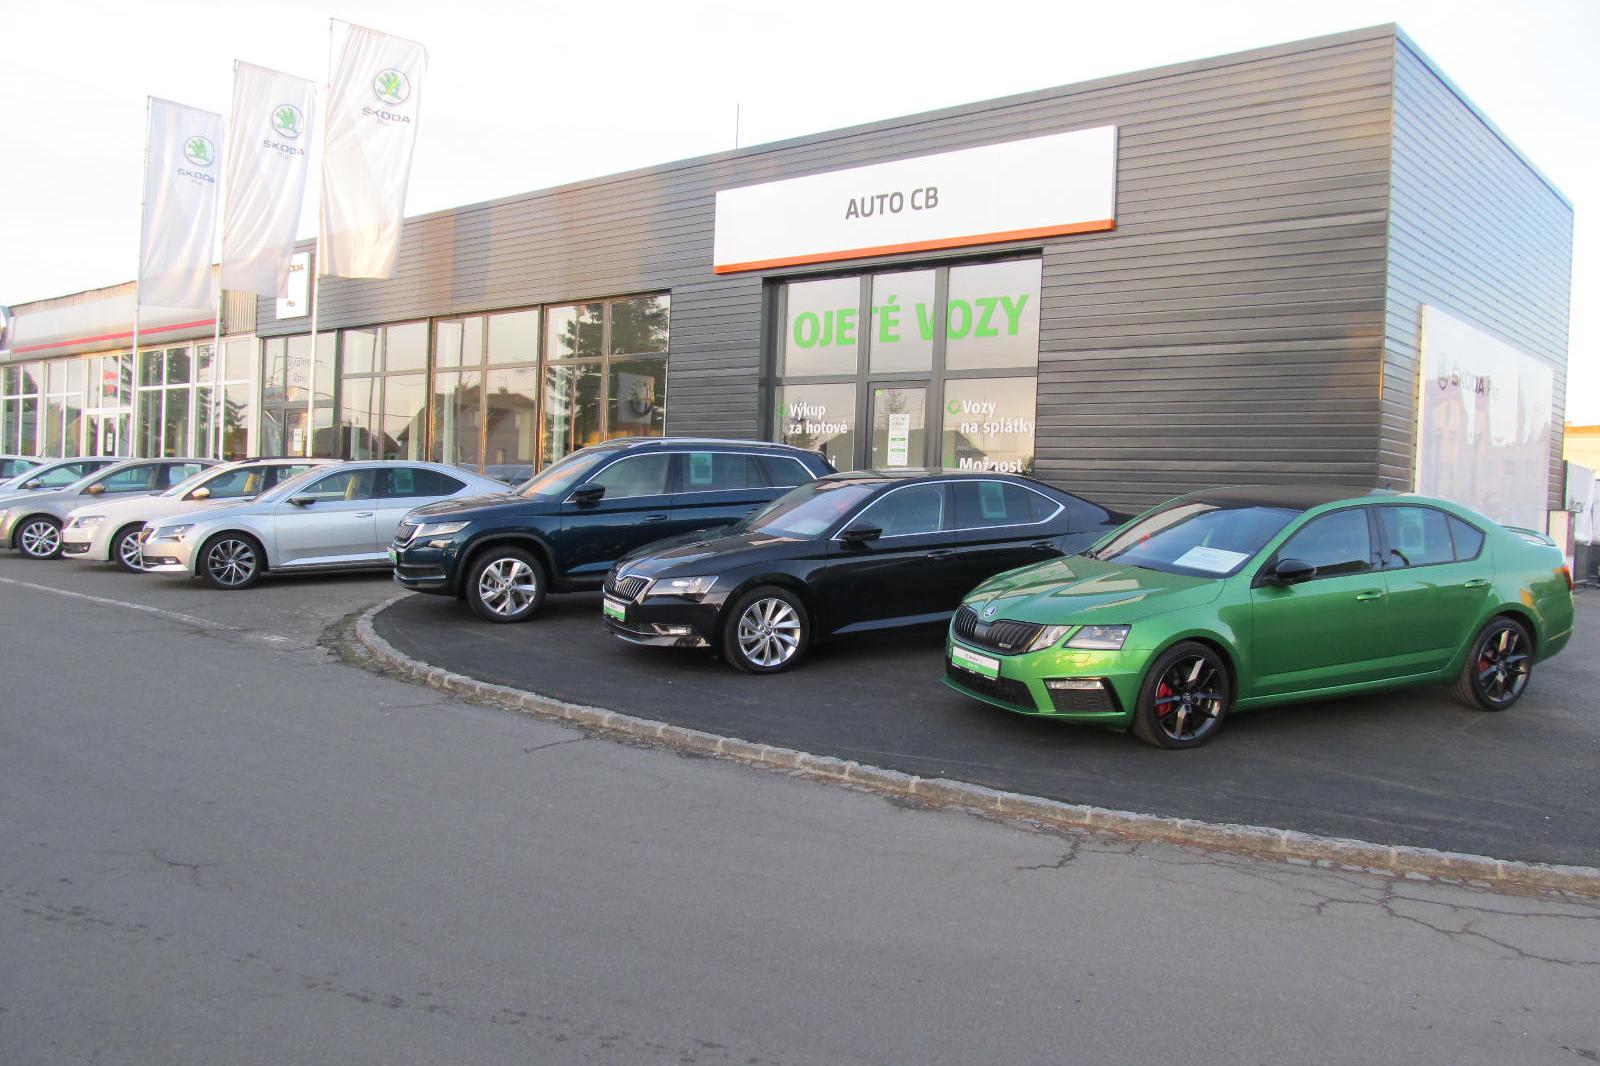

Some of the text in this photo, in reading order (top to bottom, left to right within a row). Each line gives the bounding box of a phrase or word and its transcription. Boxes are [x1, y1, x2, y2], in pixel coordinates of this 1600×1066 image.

[845, 186, 940, 220] AUTO CB
[793, 294, 1030, 349] OJEÉ VOZY
[789, 402, 826, 421] Výkup
[963, 399, 997, 418] Vozy
[789, 418, 848, 435] za hotové
[961, 417, 1035, 439] na splátky
[959, 457, 1023, 473] Možnost
